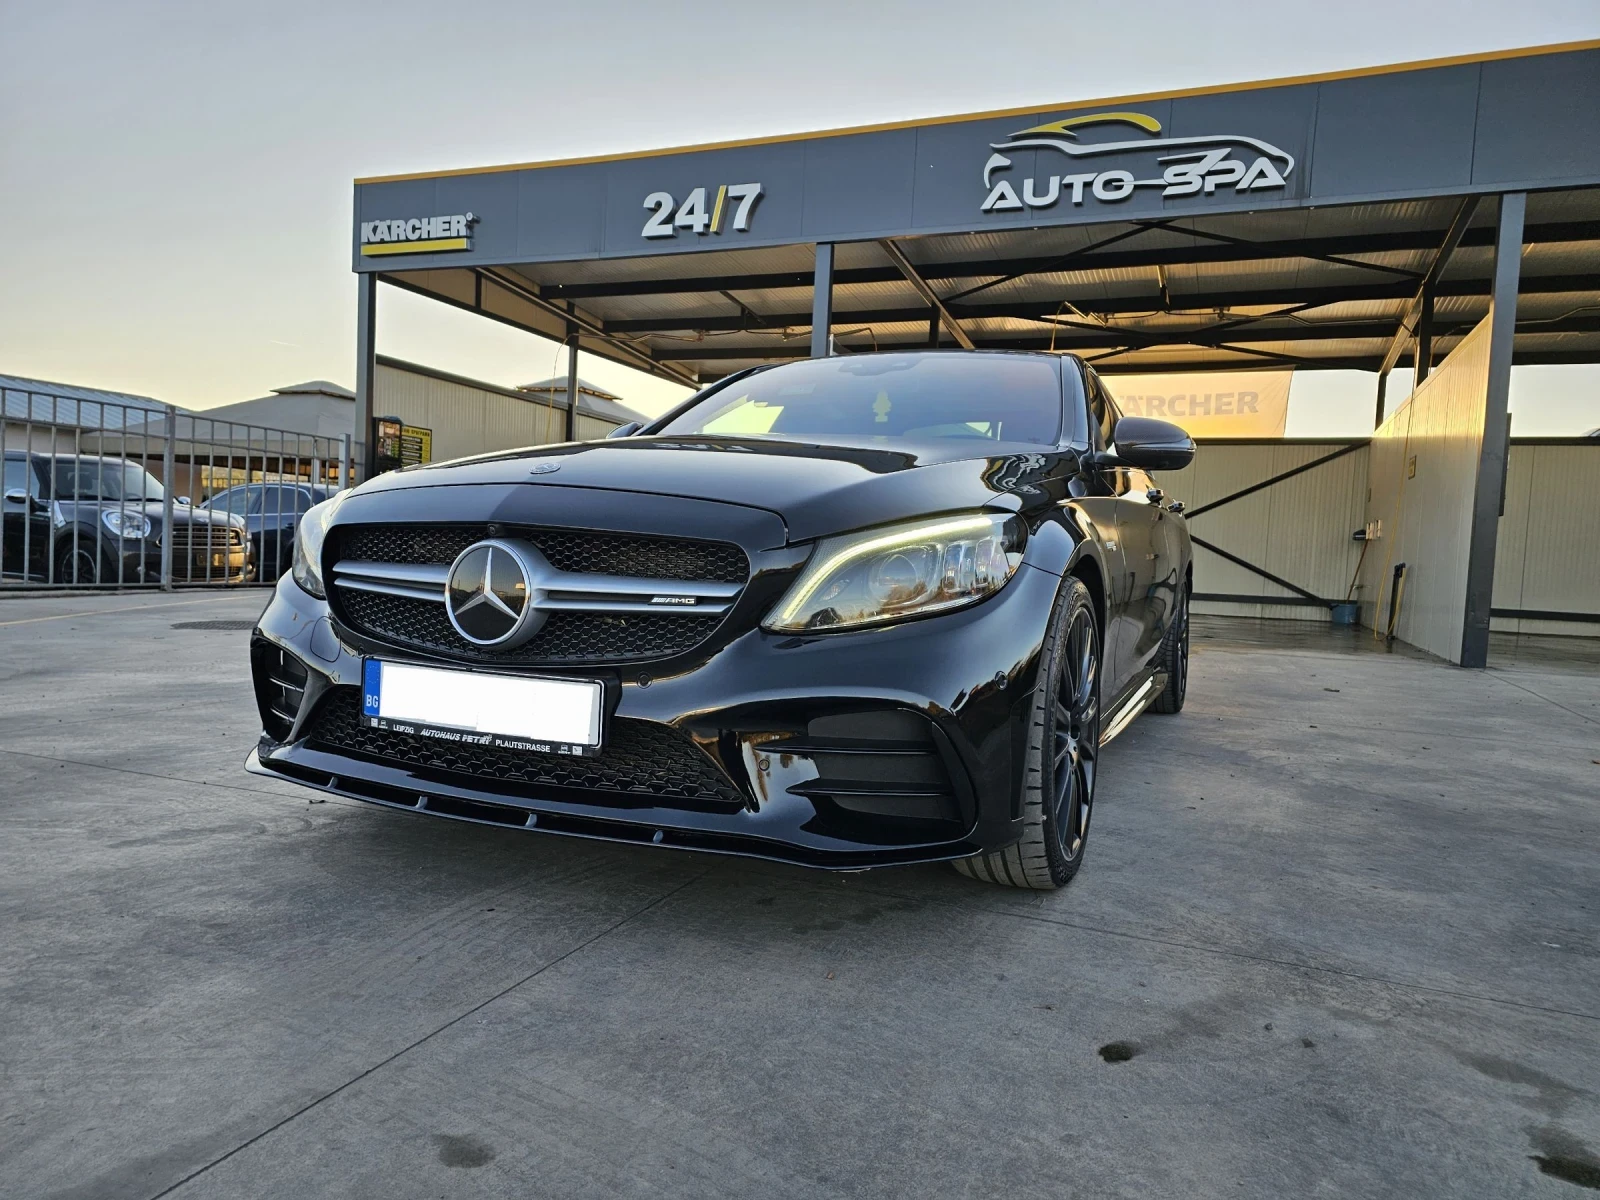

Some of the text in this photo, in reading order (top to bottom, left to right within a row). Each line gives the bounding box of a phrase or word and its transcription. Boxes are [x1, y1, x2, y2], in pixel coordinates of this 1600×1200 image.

[979, 148, 1287, 210] AUTO SPA
[641, 182, 761, 237] 24/7
[1118, 391, 1260, 417] ÄRCHER
[366, 694, 379, 708] BG
[392, 723, 415, 734] LEIPZIG
[420, 728, 461, 741] AUTOHAUS
[495, 739, 551, 753] PLAUTSTRASSE
